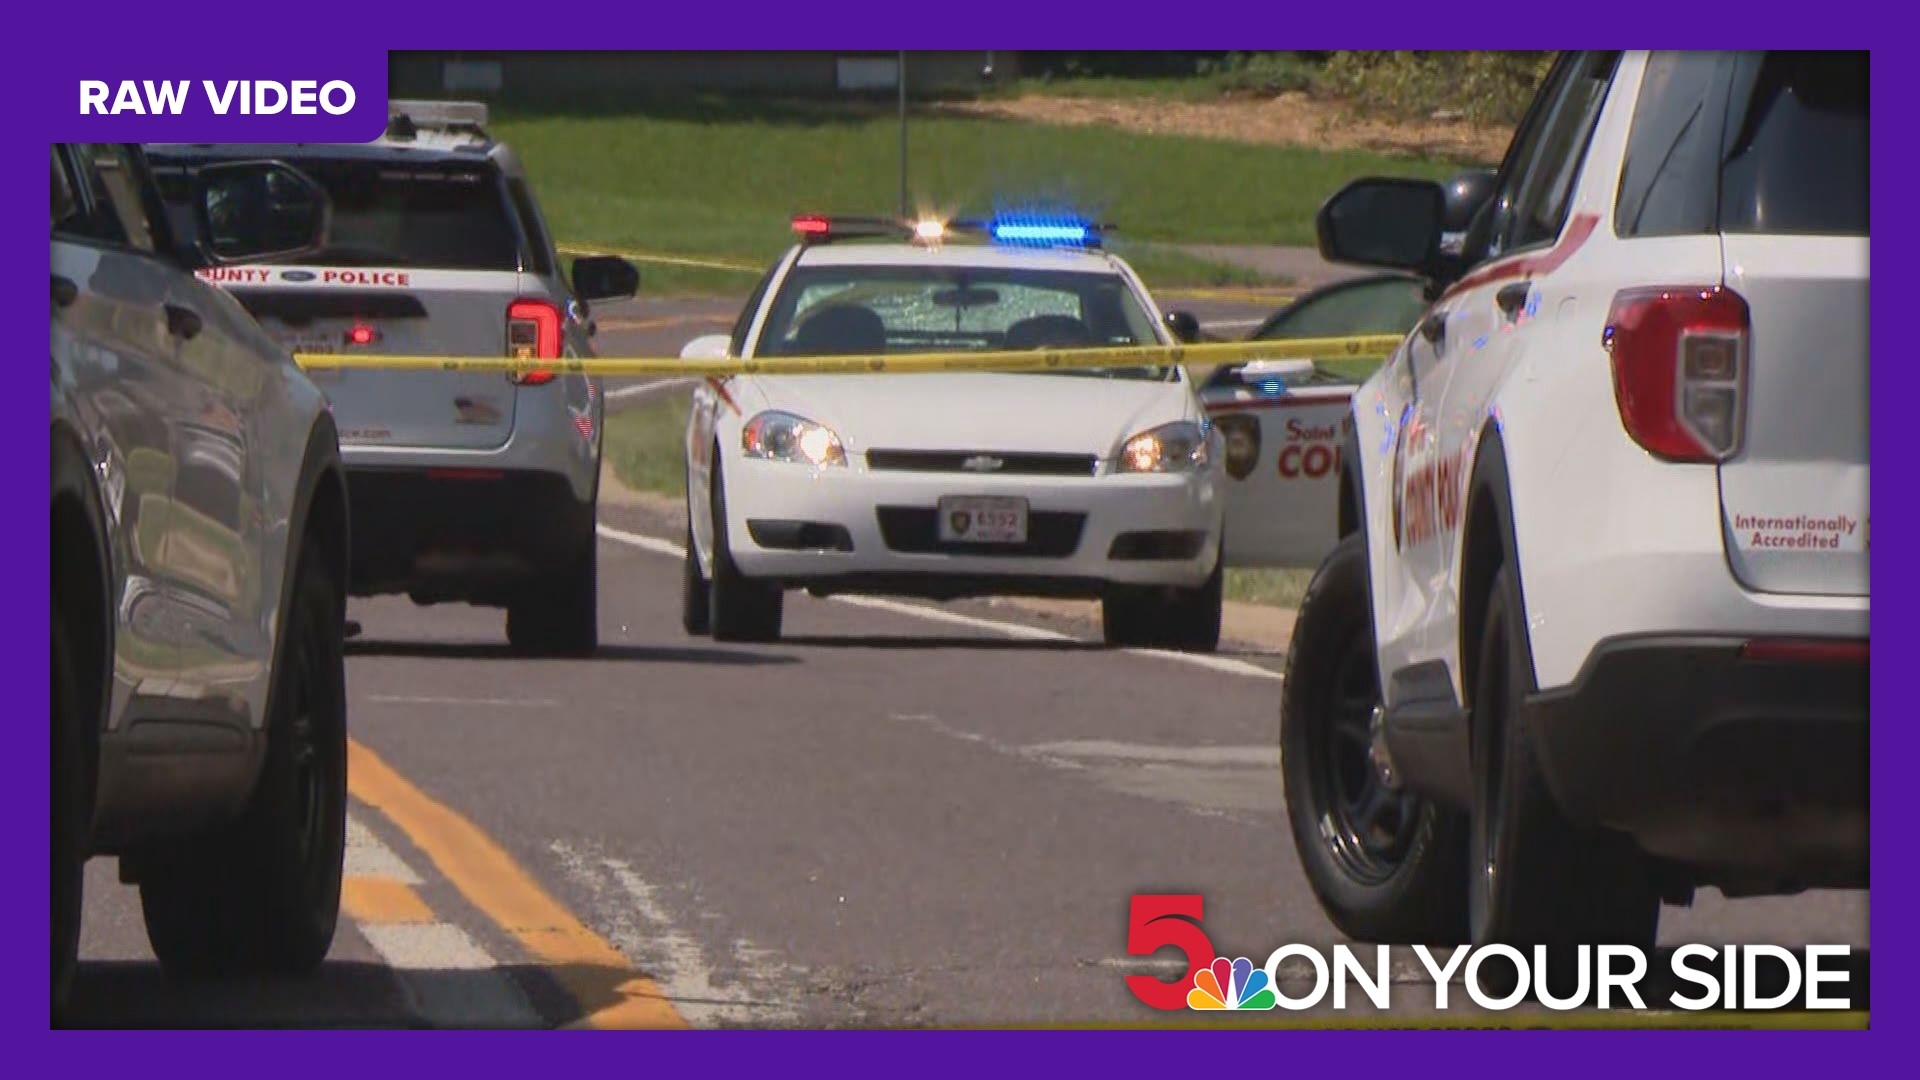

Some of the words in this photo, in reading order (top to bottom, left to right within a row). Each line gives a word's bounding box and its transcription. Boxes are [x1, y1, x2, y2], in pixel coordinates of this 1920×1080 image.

[323, 271, 410, 287] POLICE
[1286, 418, 1335, 443] Saint
[1735, 513, 1857, 535] Internationally
[1751, 531, 1840, 548] Accredited
